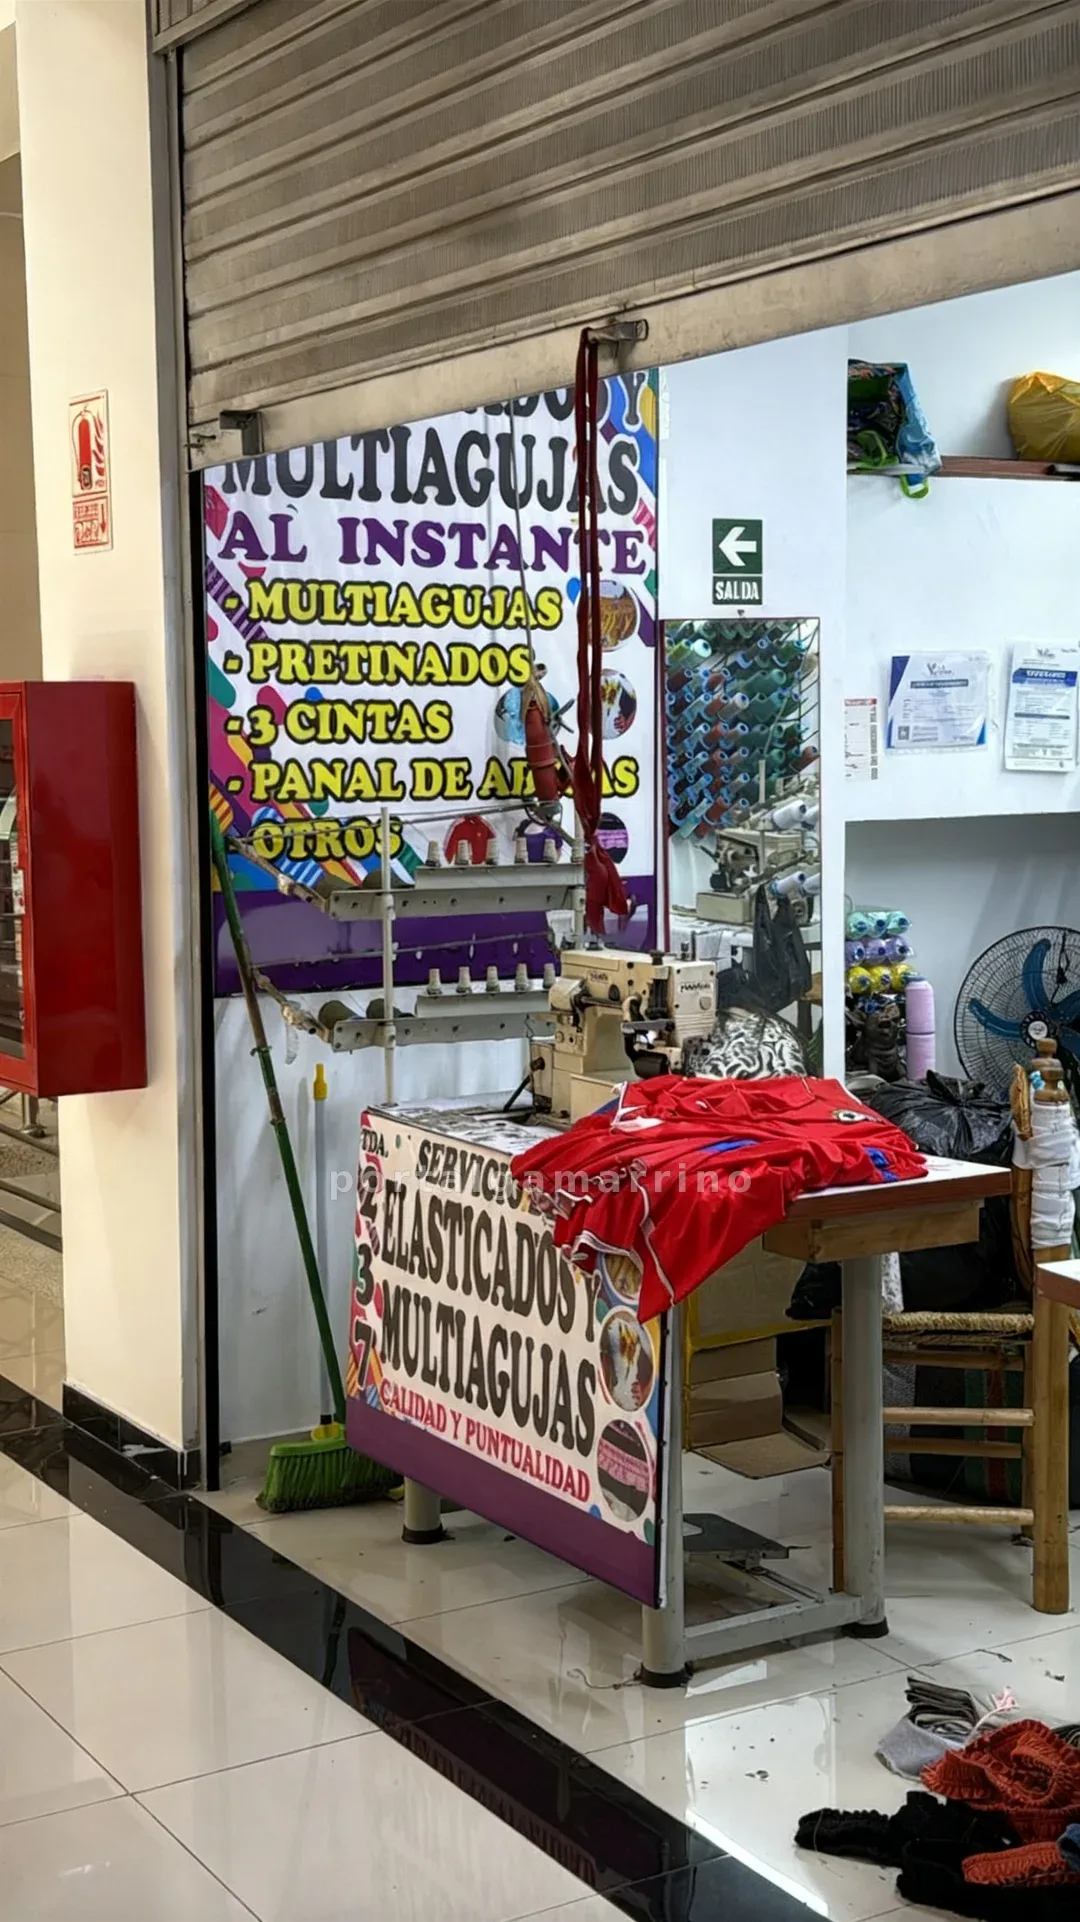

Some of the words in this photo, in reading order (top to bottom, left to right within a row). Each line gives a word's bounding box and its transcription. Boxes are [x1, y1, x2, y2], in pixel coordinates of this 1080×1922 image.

[218, 511, 308, 563] AL
[338, 516, 647, 575] INSTANTE
[244, 577, 563, 632] MULTIAGUJAS
[247, 638, 533, 686] PRETINADOS
[248, 704, 278, 746] 3
[285, 699, 452, 744] CINTAS
[249, 753, 404, 803] PANAL
[410, 756, 472, 800] DE
[251, 815, 403, 861] OTROS
[380, 1179, 576, 1334] ELASTICADOS
[380, 1279, 597, 1458] MULTIAGUJAS
[380, 1377, 447, 1434] CALIDAD
[450, 1409, 462, 1441] Y
[465, 1415, 592, 1503] PUNTUALIDAD
